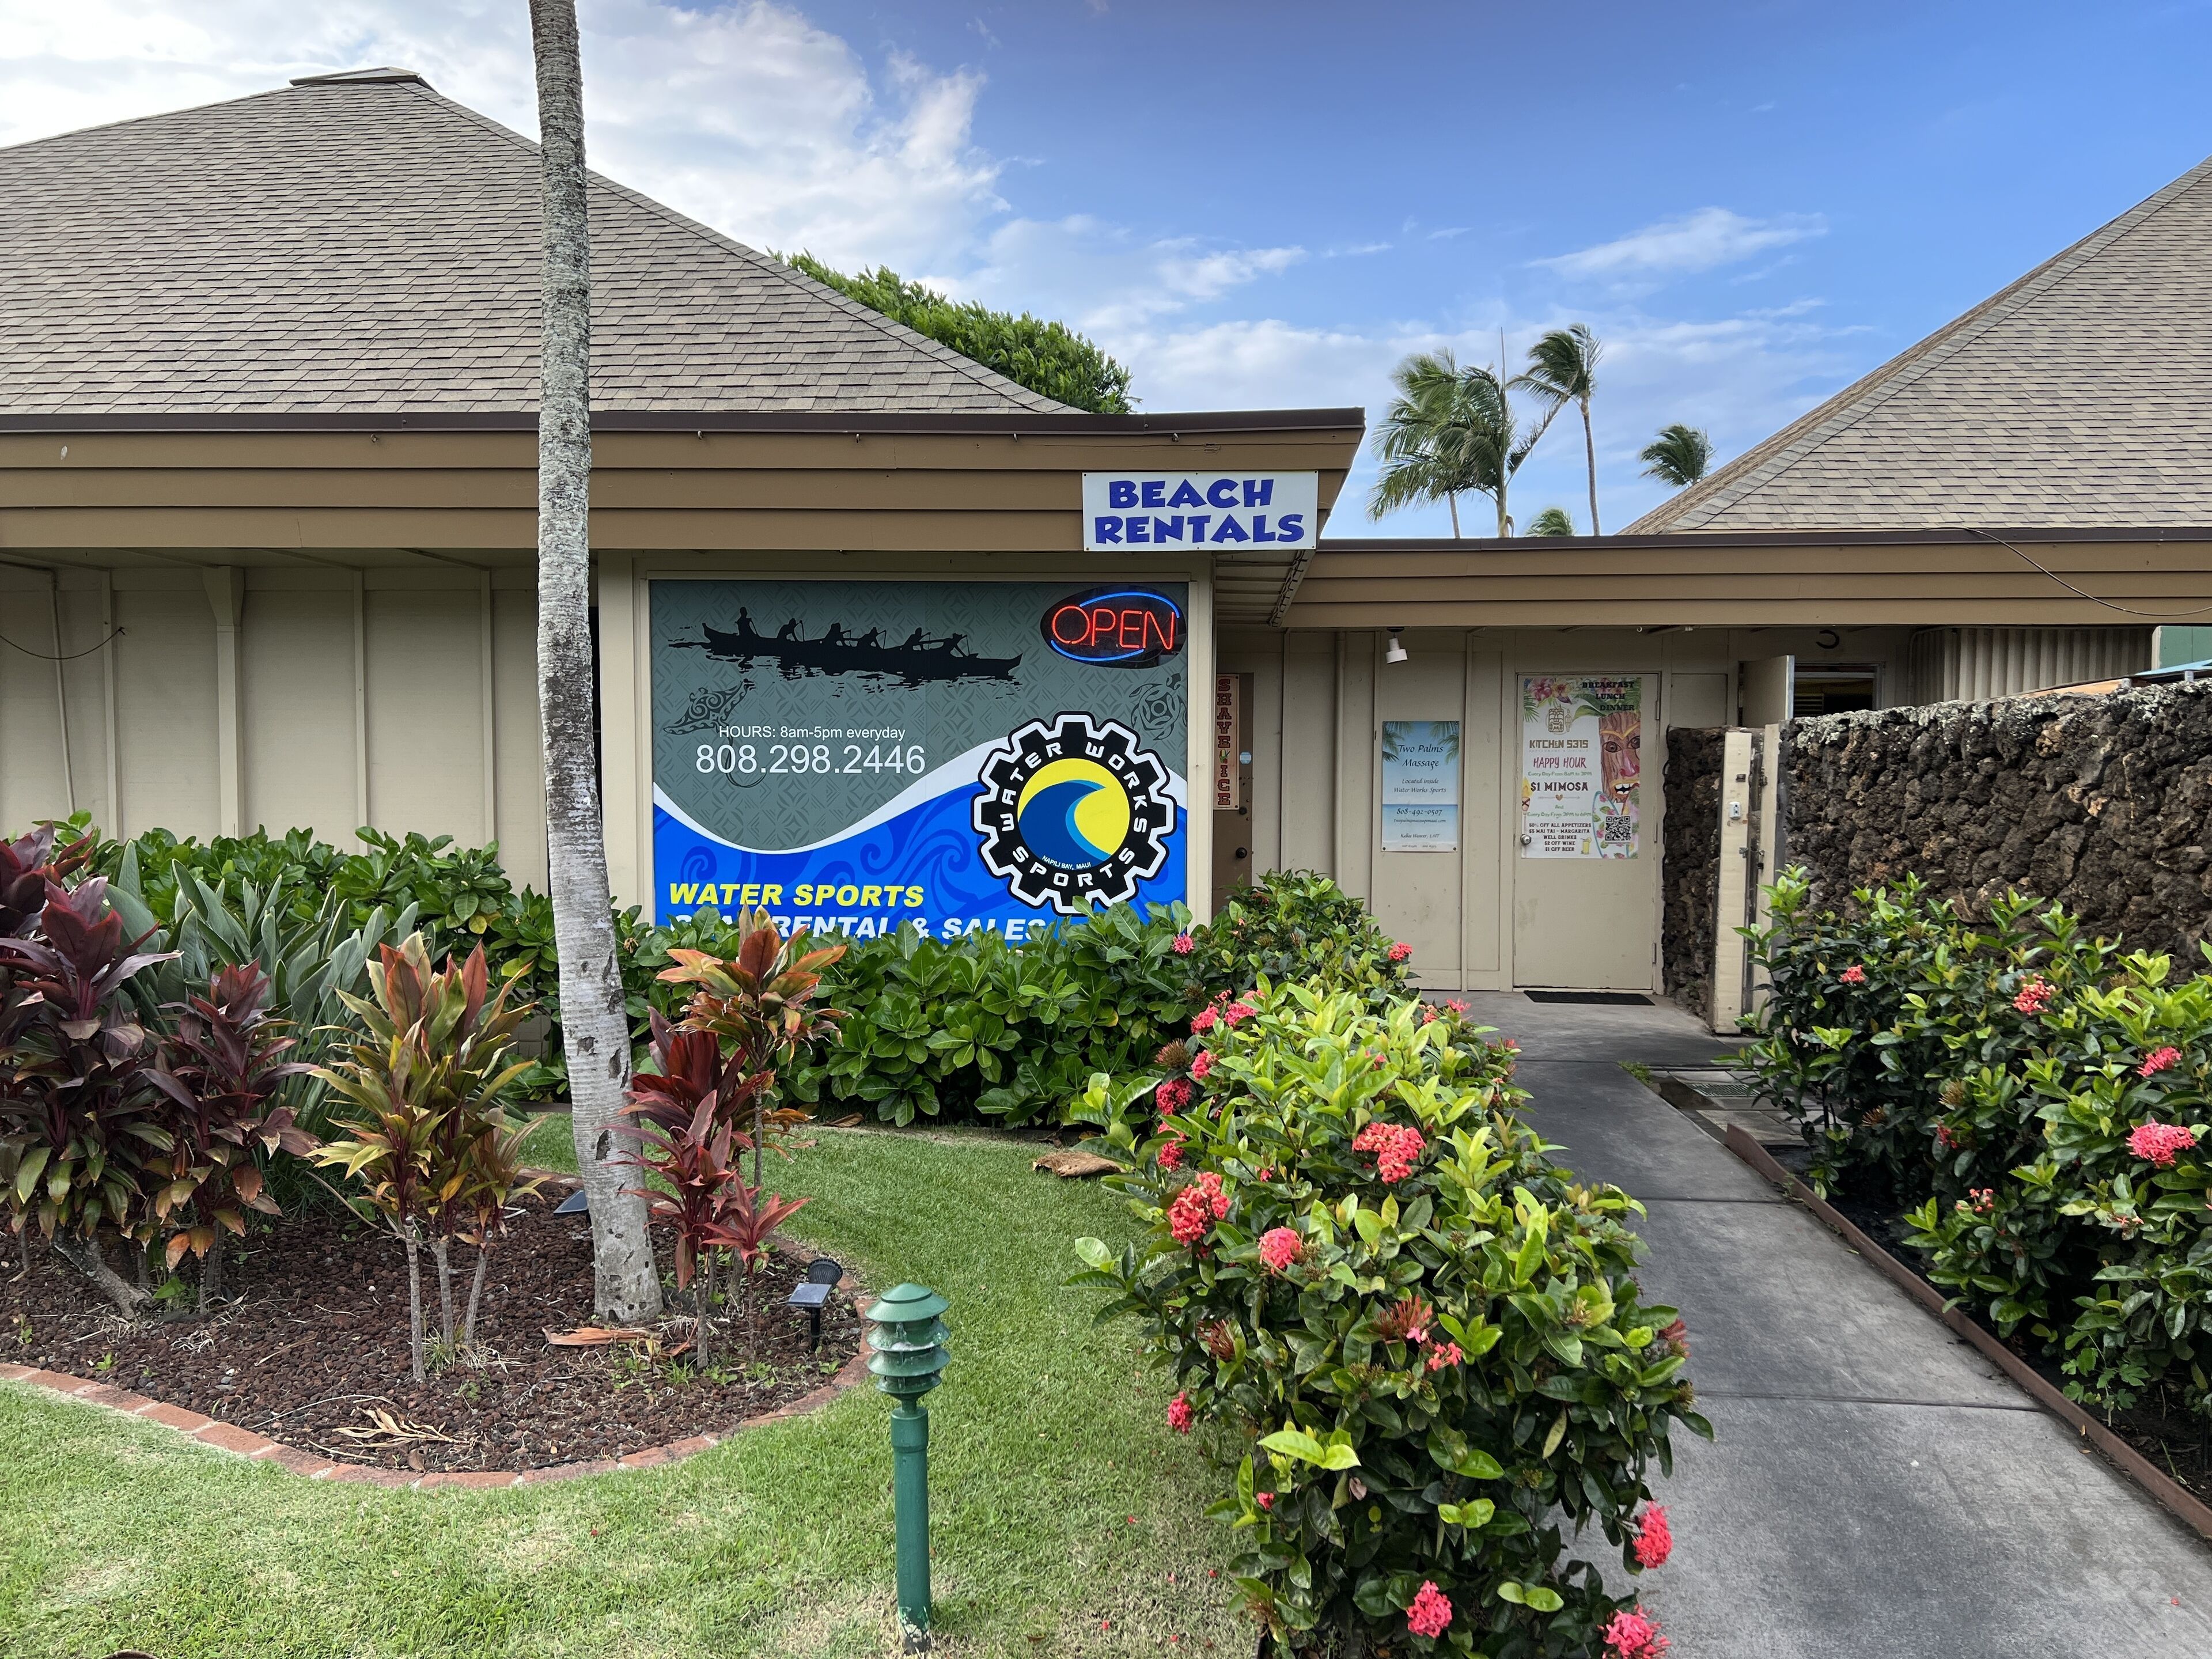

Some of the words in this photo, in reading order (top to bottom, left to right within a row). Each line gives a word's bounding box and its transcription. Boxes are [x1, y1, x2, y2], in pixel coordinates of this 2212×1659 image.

[1109, 479, 1274, 508] BEACH
[1094, 514, 1305, 544] RENTALS
[1052, 605, 1175, 650] OPEN
[1217, 678, 1232, 748] SHAVE
[719, 726, 776, 738] HOURS:
[780, 726, 842, 741] 8am-5pm
[846, 726, 906, 741] everyday
[1529, 740, 1564, 748] KITCHEN
[1566, 740, 1588, 748] 5315
[695, 744, 925, 775] 808.298.2446
[1397, 744, 1415, 752] Two
[1418, 744, 1444, 753] Palms
[1402, 759, 1439, 771] Massage
[1533, 756, 1559, 768] HAPPY
[1563, 756, 1586, 768] HOUR
[999, 741, 1063, 831] WATER
[1085, 741, 1148, 834] WORKS
[1217, 765, 1231, 805] ICE
[1531, 781, 1540, 791] $1
[1544, 782, 1588, 791] MIMOSA
[1396, 808, 1442, 816] 808-492-0507
[1012, 845, 1135, 888] SPORTS
[1041, 855, 1061, 868] NAPILI
[669, 882, 783, 906] WATER
[793, 885, 925, 907] SPORTS
